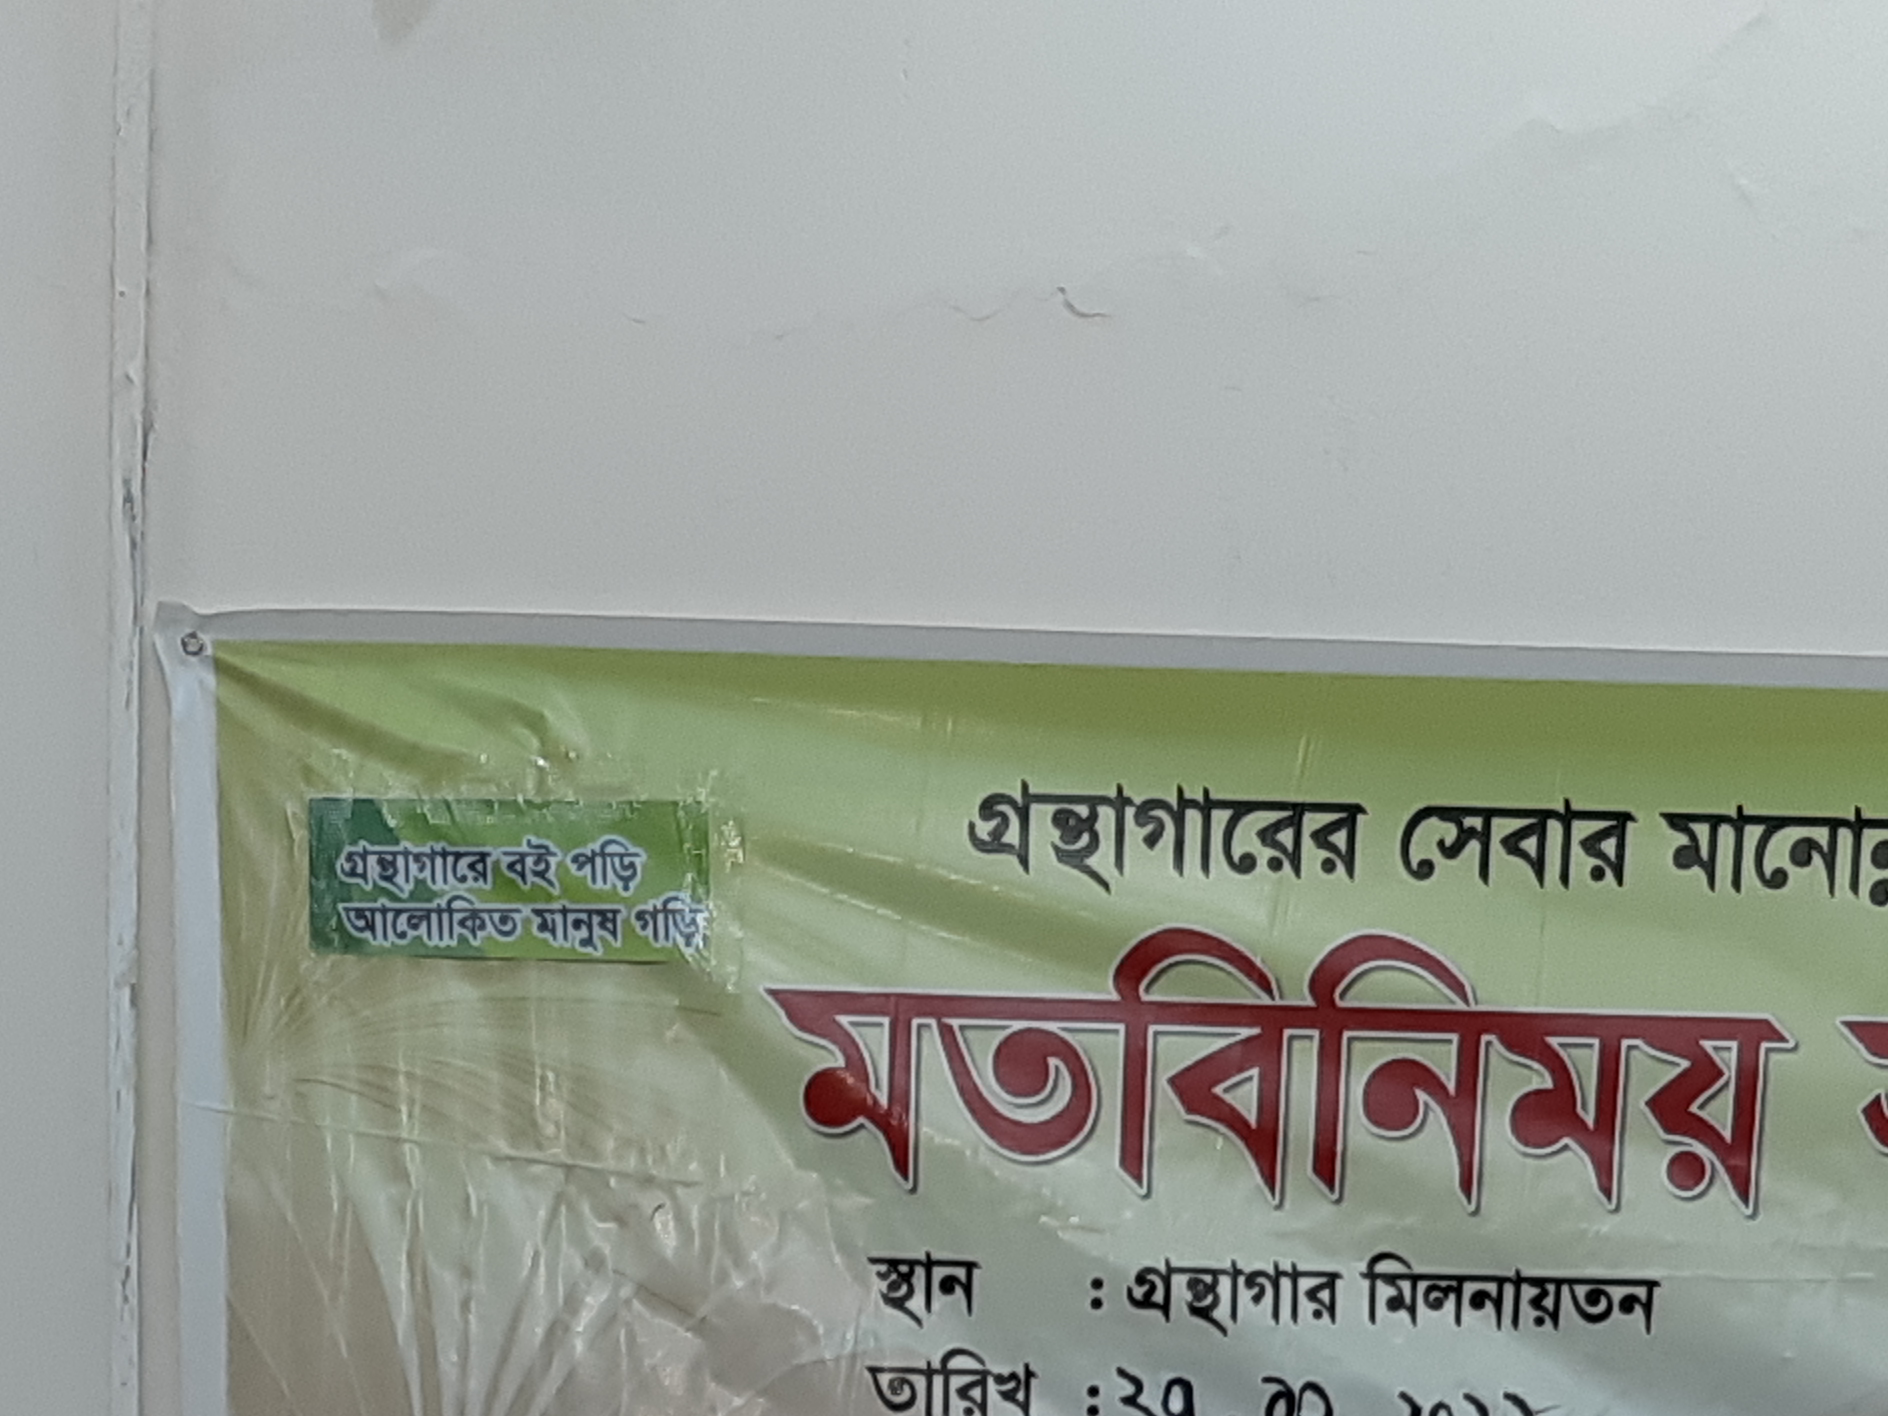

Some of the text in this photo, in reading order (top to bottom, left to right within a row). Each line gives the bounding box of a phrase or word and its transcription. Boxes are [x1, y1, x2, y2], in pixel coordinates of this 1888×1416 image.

[340, 837, 643, 893] গ্রন্থাগারে বই পড়ি
[967, 778, 1367, 894] গ্রন্থাগারের
[1398, 801, 1636, 889] সেবার
[343, 896, 521, 946] আলোকিত
[530, 906, 624, 953] মানুষ
[760, 928, 1794, 1217] মতবিনিময়
[868, 1252, 982, 1328] স্থান
[1125, 1257, 1341, 1336] গ্রন্থাগার
[1362, 1252, 1661, 1336] মিলনায়তন
